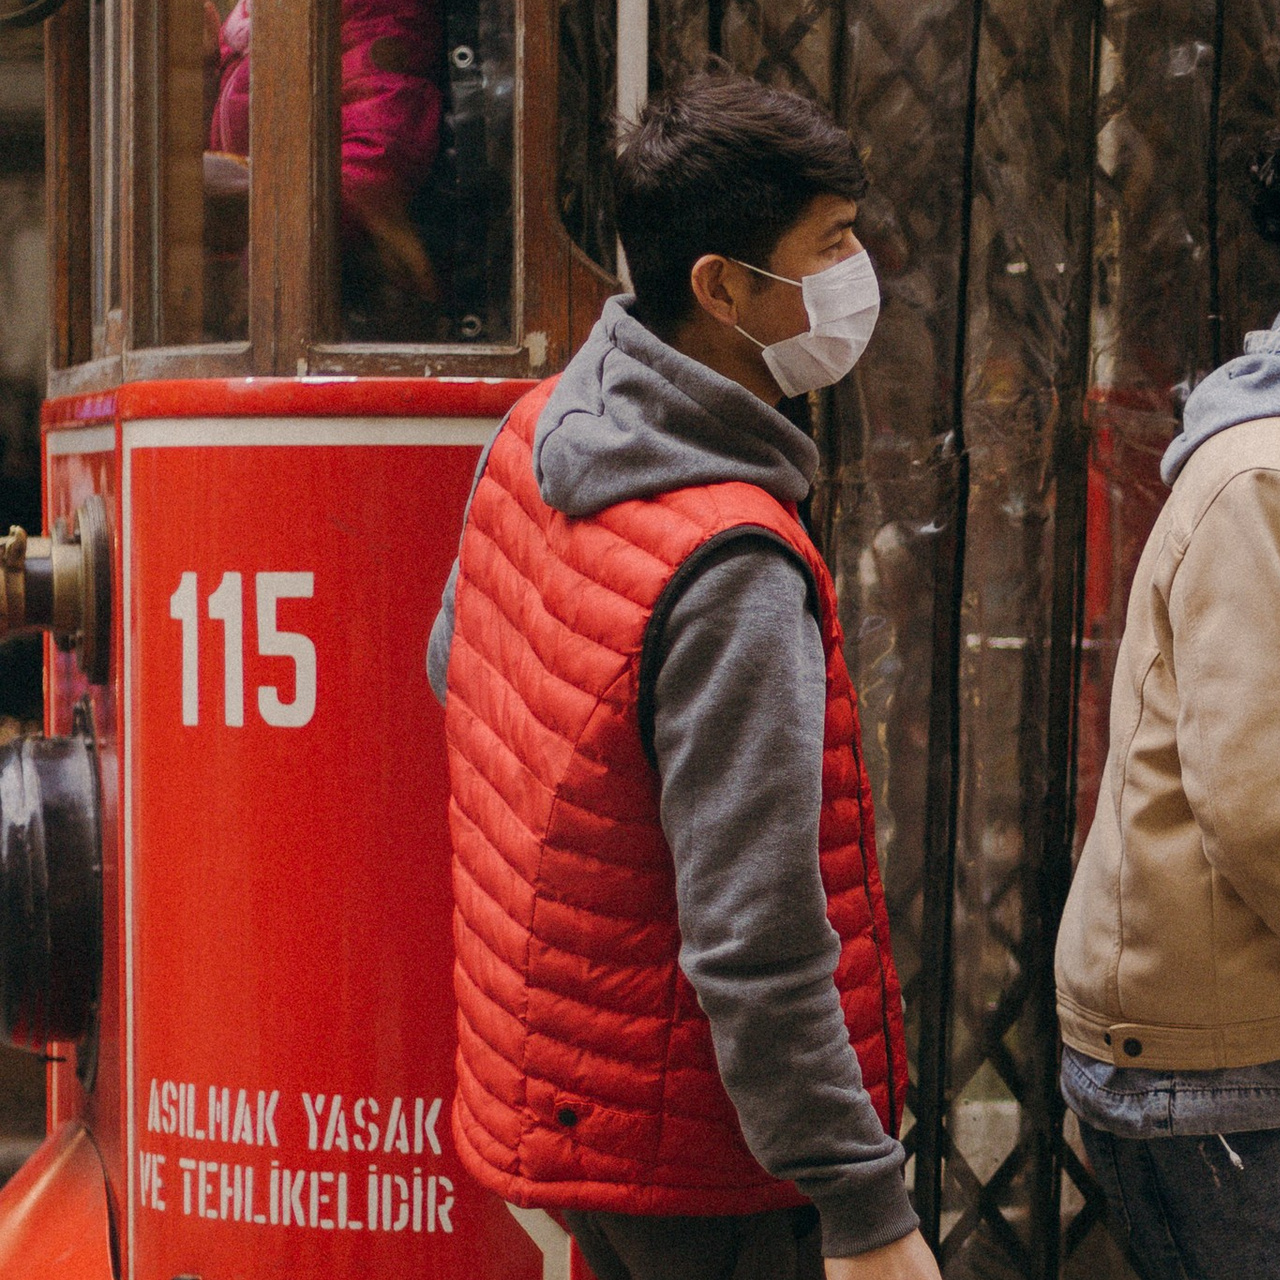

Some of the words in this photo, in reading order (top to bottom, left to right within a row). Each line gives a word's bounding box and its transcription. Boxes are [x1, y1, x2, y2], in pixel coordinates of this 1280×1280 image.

[169, 571, 317, 728] 115
[147, 1077, 280, 1148] ASILMAK
[301, 1091, 442, 1156] YASAK
[139, 1150, 166, 1212] VE
[178, 1157, 455, 1234] TEHLİKELİDİR
